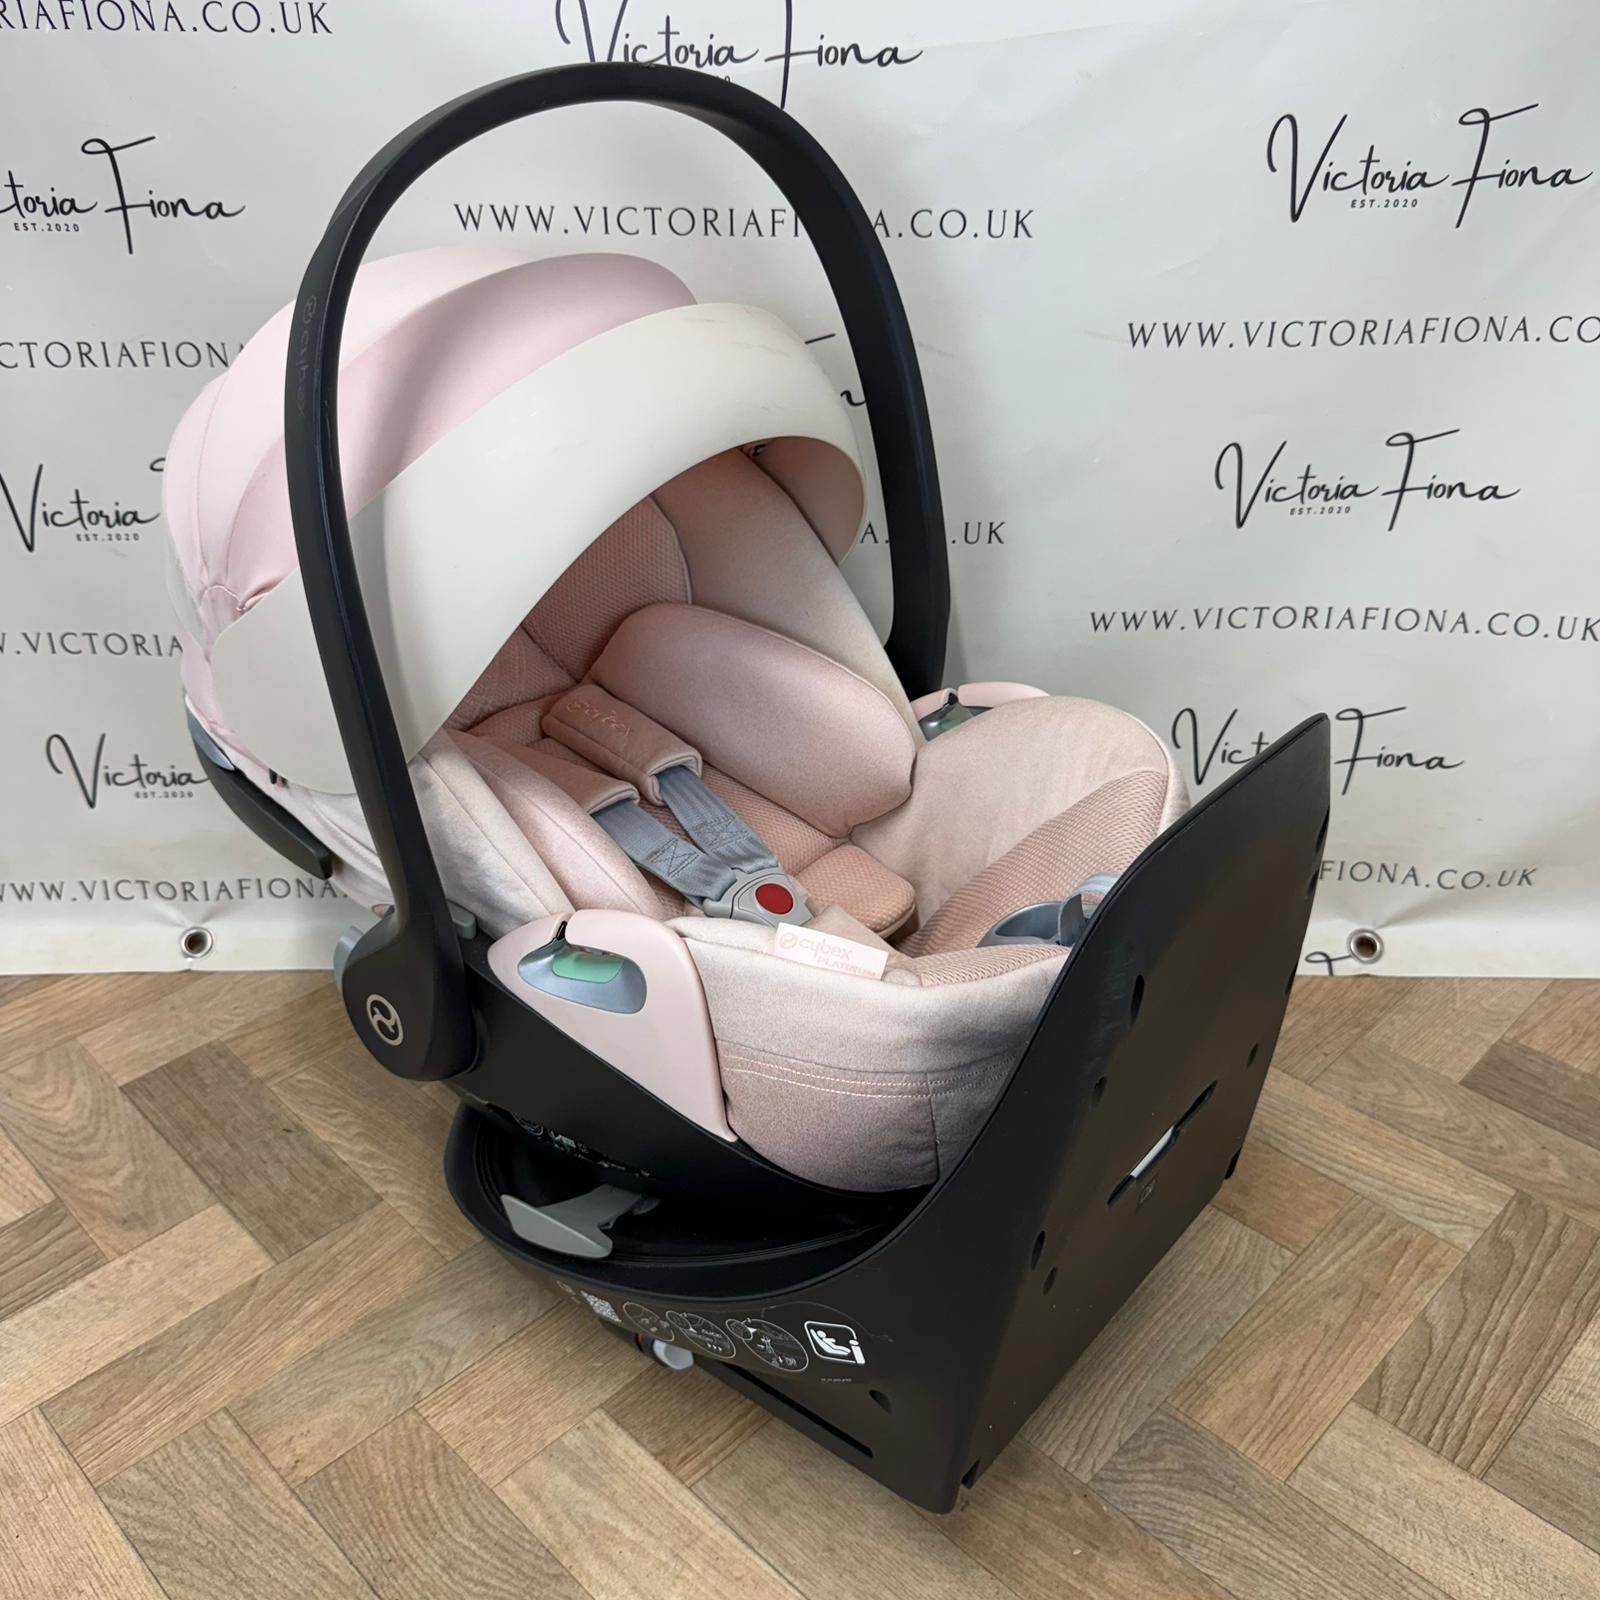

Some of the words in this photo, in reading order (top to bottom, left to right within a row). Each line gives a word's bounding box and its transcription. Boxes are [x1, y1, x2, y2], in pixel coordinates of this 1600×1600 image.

[1266, 114, 1449, 223] Victoria
[1452, 103, 1593, 229] Fiona
[0, 170, 98, 218] toria
[81, 136, 246, 255] Fiona
[1350, 198, 1419, 209] EST.2020
[14, 222, 80, 232] EST.2020
[454, 203, 1034, 240] WWW.VICTORIAFIA.CO.UK
[1127, 315, 1600, 349] WWW.VICTORIAFIONA.CO
[0, 341, 244, 369] CTORIAFION
[1214, 441, 1379, 529] Victoria
[1381, 429, 1521, 532] Fiona
[0, 464, 160, 552] Victoria
[1289, 505, 1351, 515] EST.2020
[1090, 605, 1600, 642] WWW.VICTORIAFIONA.CO.UK
[1335, 706, 1464, 796] Fiona
[46, 733, 210, 809] Victoria
[799, 937, 853, 960] cybex
